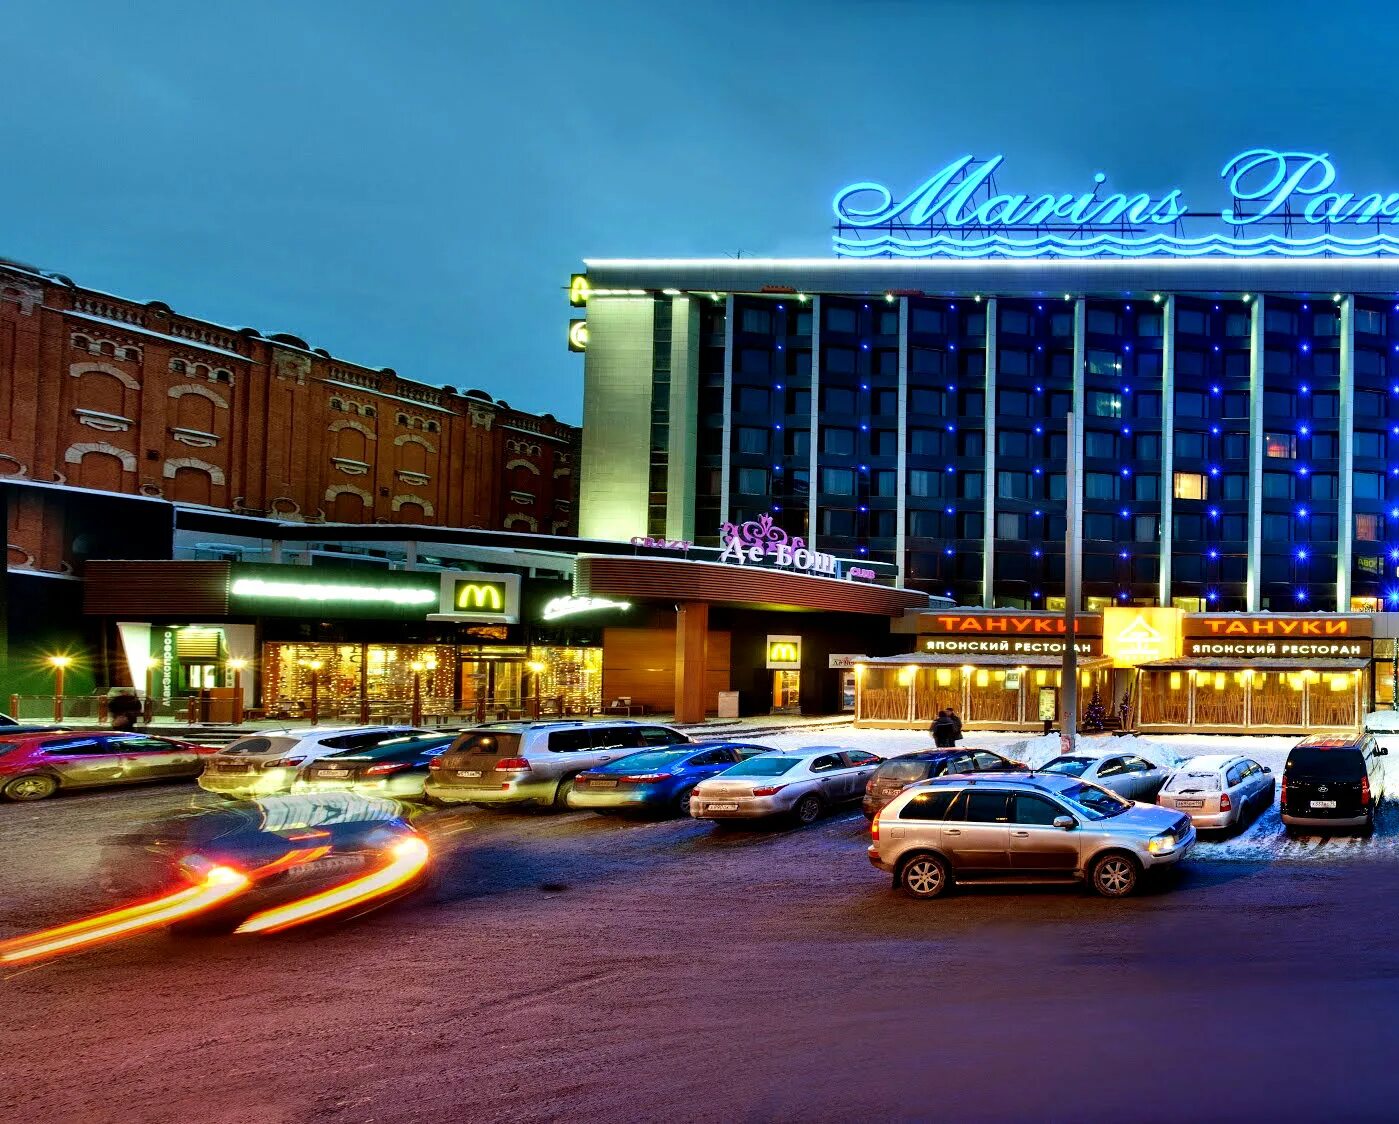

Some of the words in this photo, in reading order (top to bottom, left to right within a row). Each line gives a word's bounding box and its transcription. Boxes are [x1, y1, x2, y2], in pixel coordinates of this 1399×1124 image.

[832, 155, 1188, 227] Marins
[630, 536, 693, 551] CRAZY
[721, 536, 764, 566] Де
[1203, 620, 1348, 634] ТАНУКИ
[926, 640, 1009, 651] ЯПОНСКИЙ
[1192, 643, 1276, 654] ЯПОНСКИЙ
[1282, 645, 1361, 655] РЕСТОРАН
